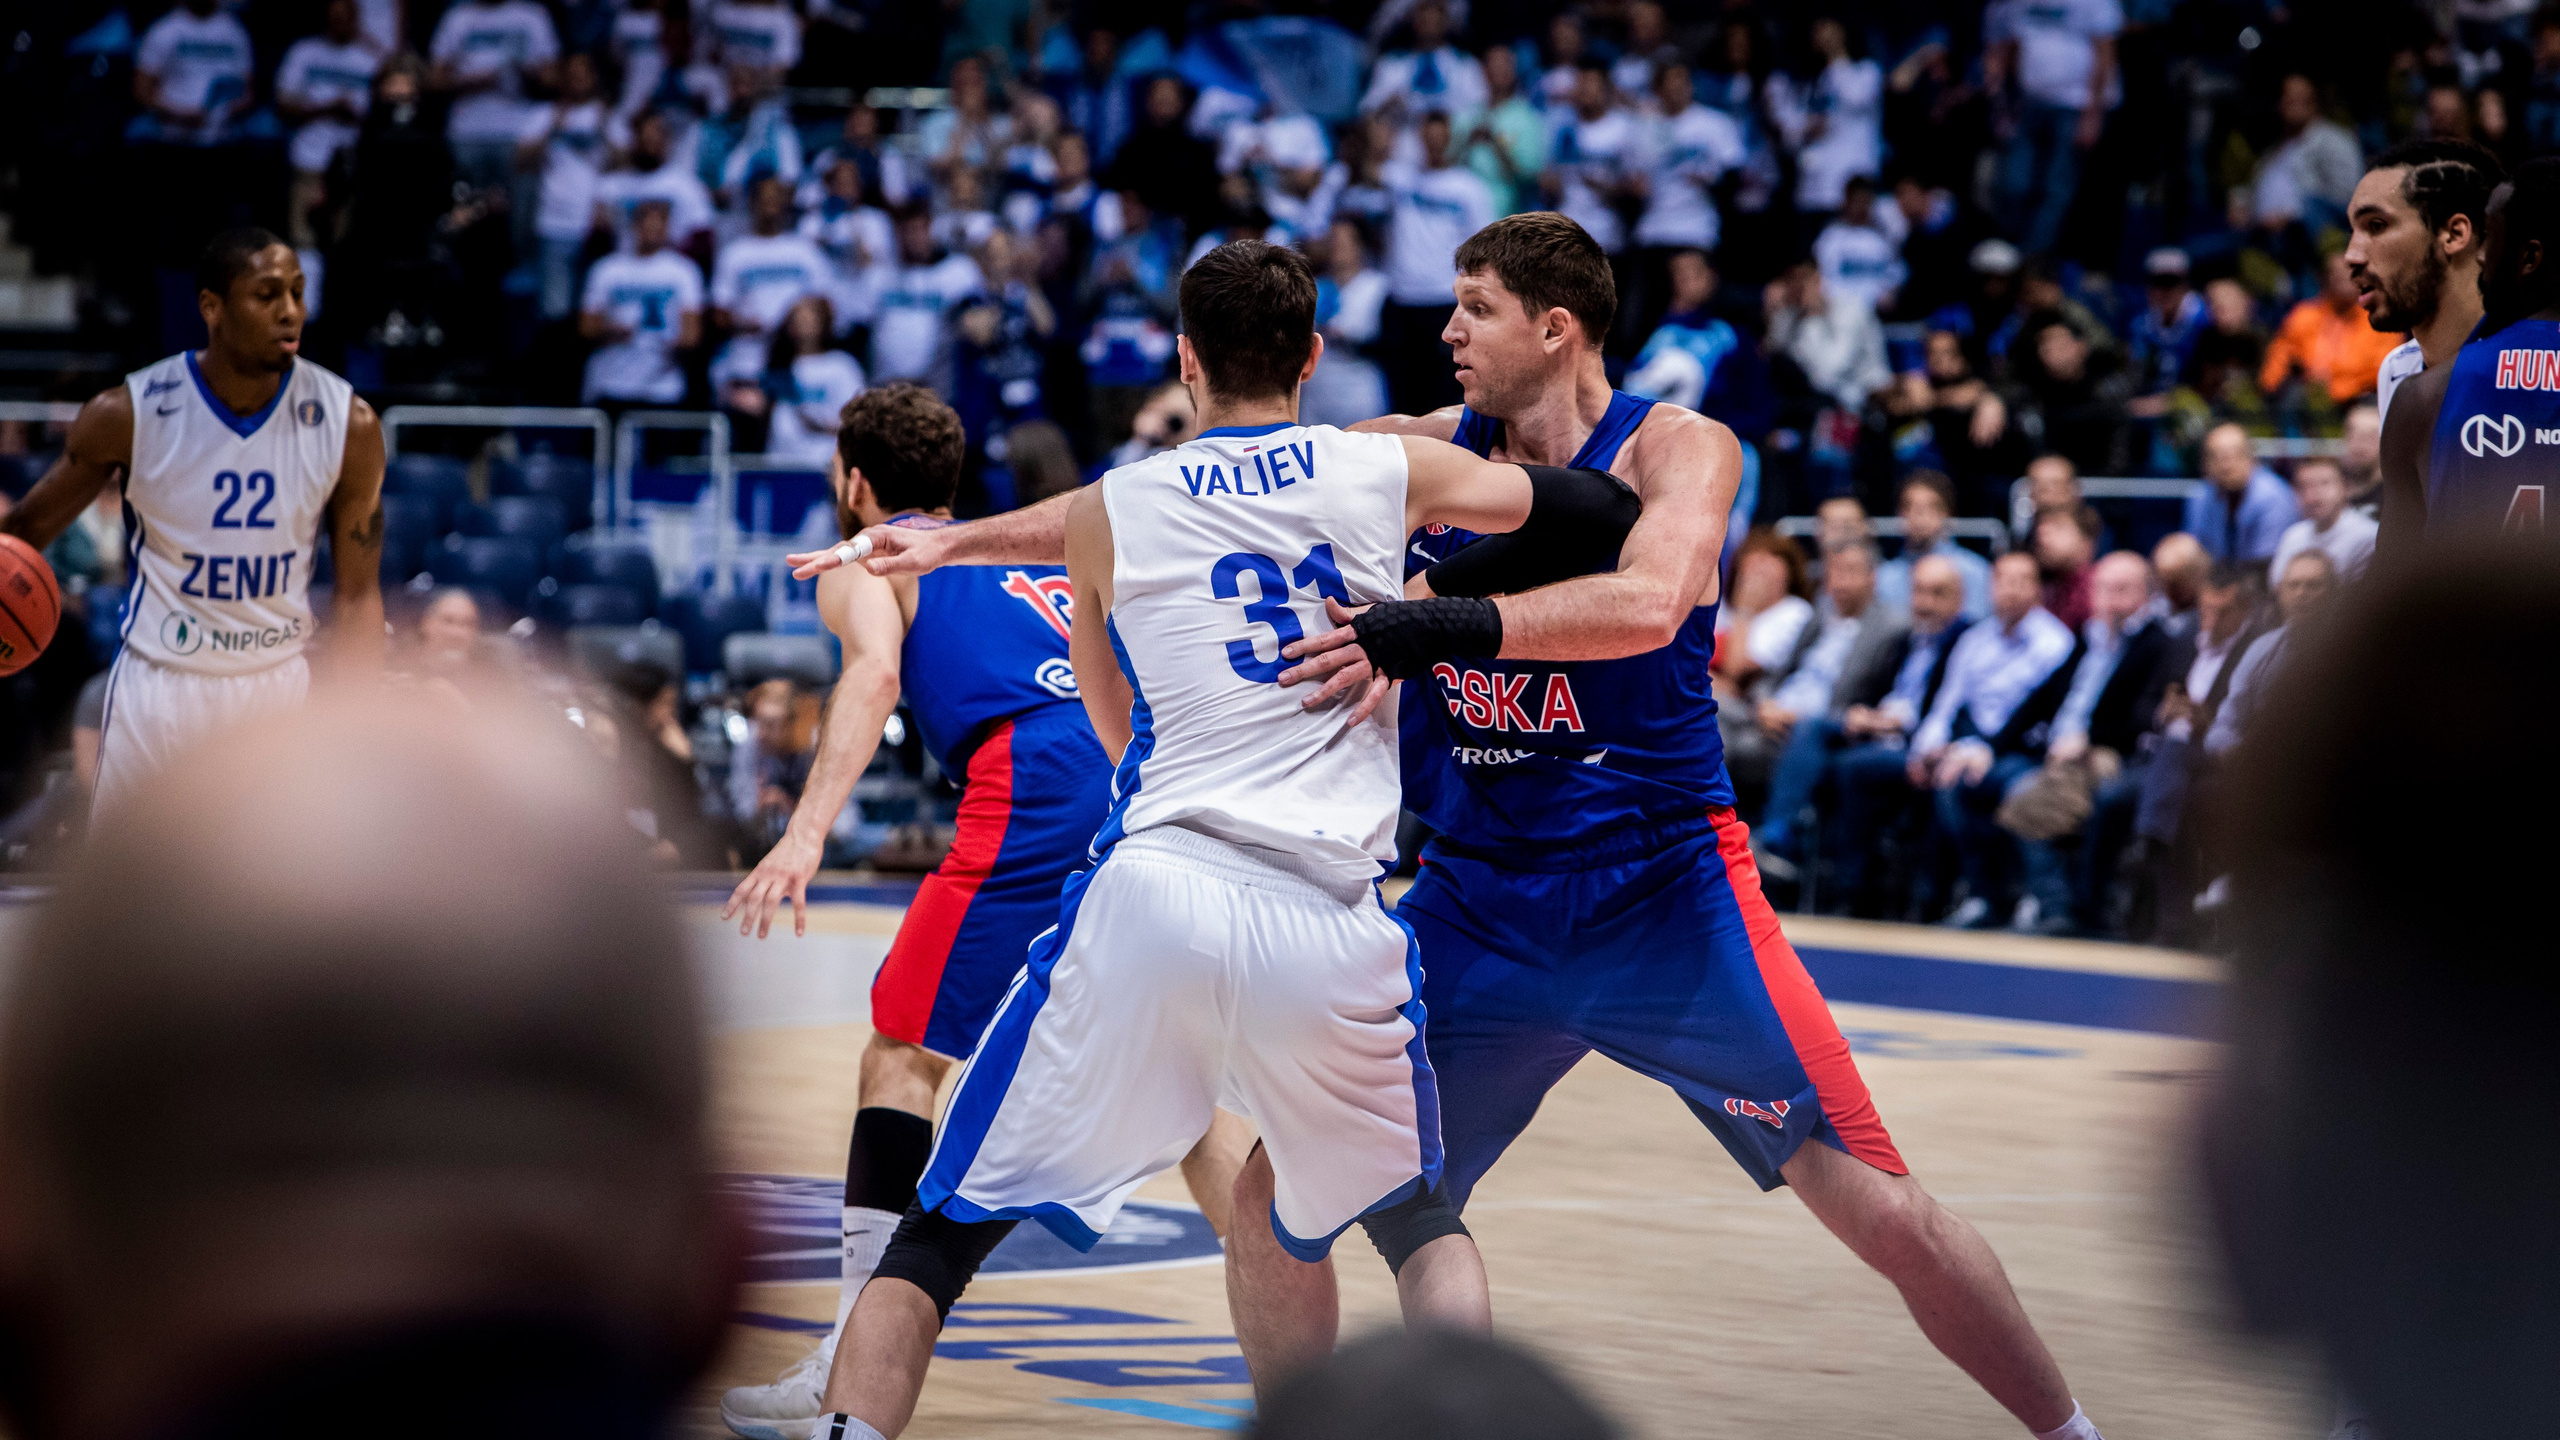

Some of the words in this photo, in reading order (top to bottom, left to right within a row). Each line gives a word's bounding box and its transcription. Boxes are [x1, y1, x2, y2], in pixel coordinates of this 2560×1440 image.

[1180, 441, 1314, 496] VALIEV
[212, 470, 275, 528] 22
[180, 549, 297, 601] ZENIT
[211, 617, 302, 651] NIPIGAS
[1211, 543, 1350, 683] 31
[1432, 662, 1585, 733] CSKA
